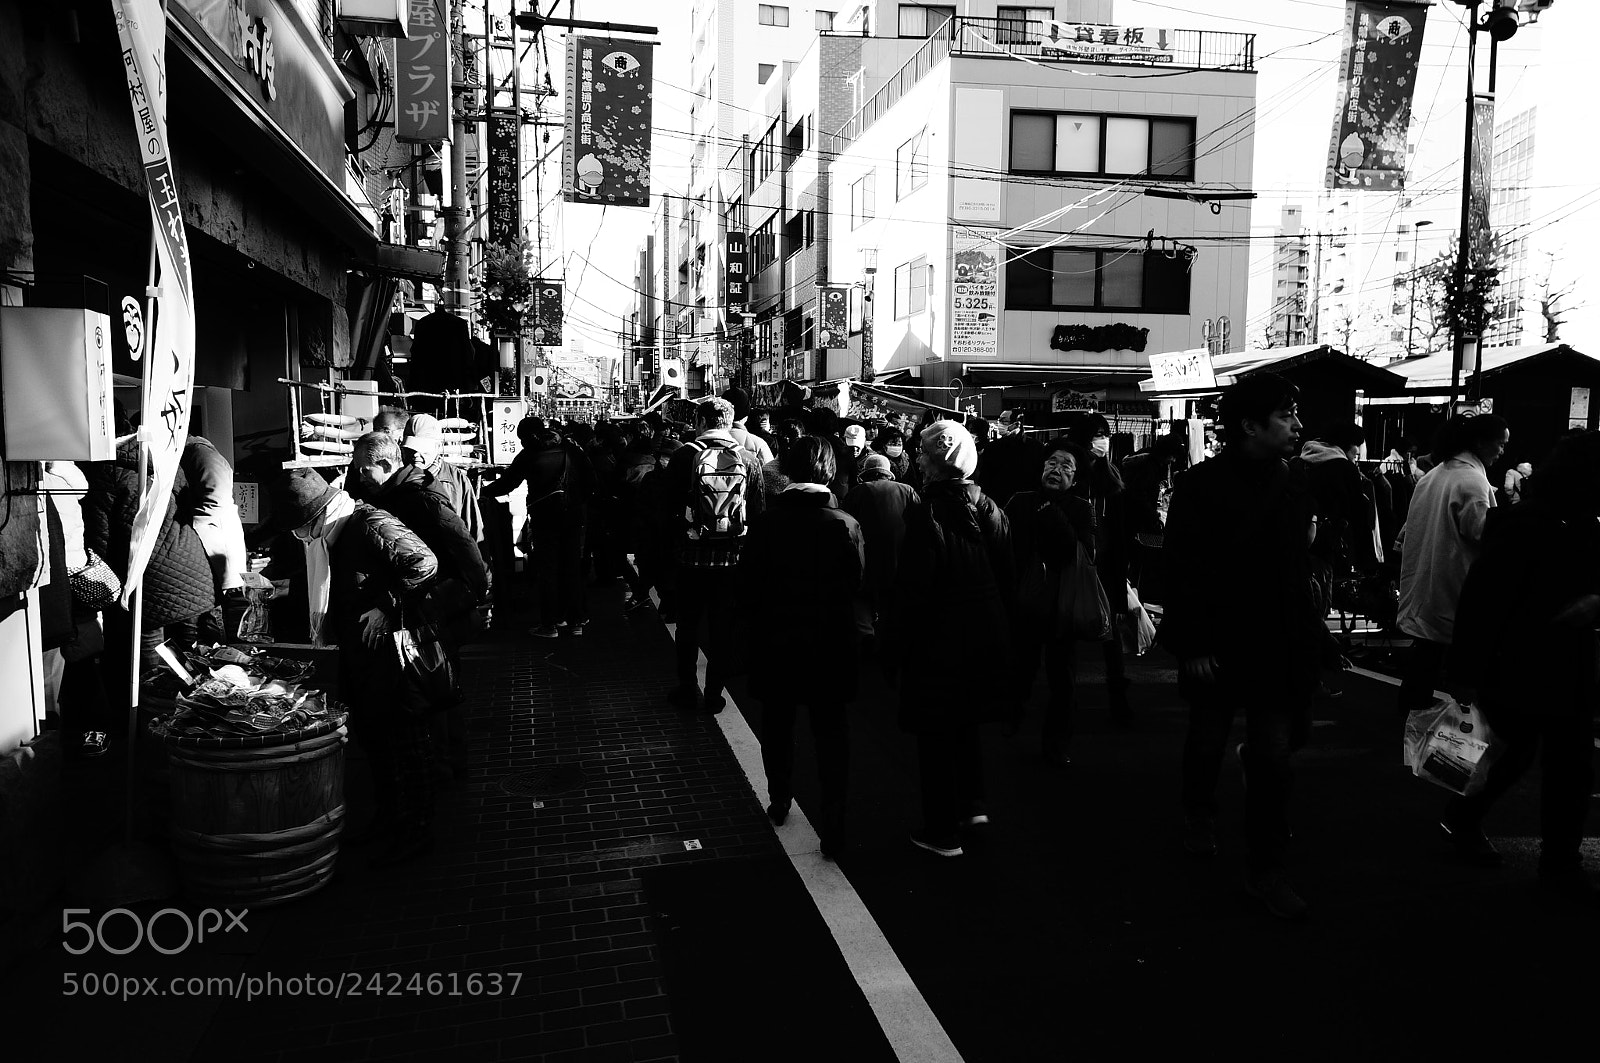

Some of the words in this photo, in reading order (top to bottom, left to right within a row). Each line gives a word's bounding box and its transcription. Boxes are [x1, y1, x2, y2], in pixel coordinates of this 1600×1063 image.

[1075, 27, 1145, 46] 貸看板
[1387, 20, 1402, 37] 商
[614, 55, 628, 71] 商
[729, 241, 743, 314] 山和証券
[500, 418, 516, 454] 初詣
